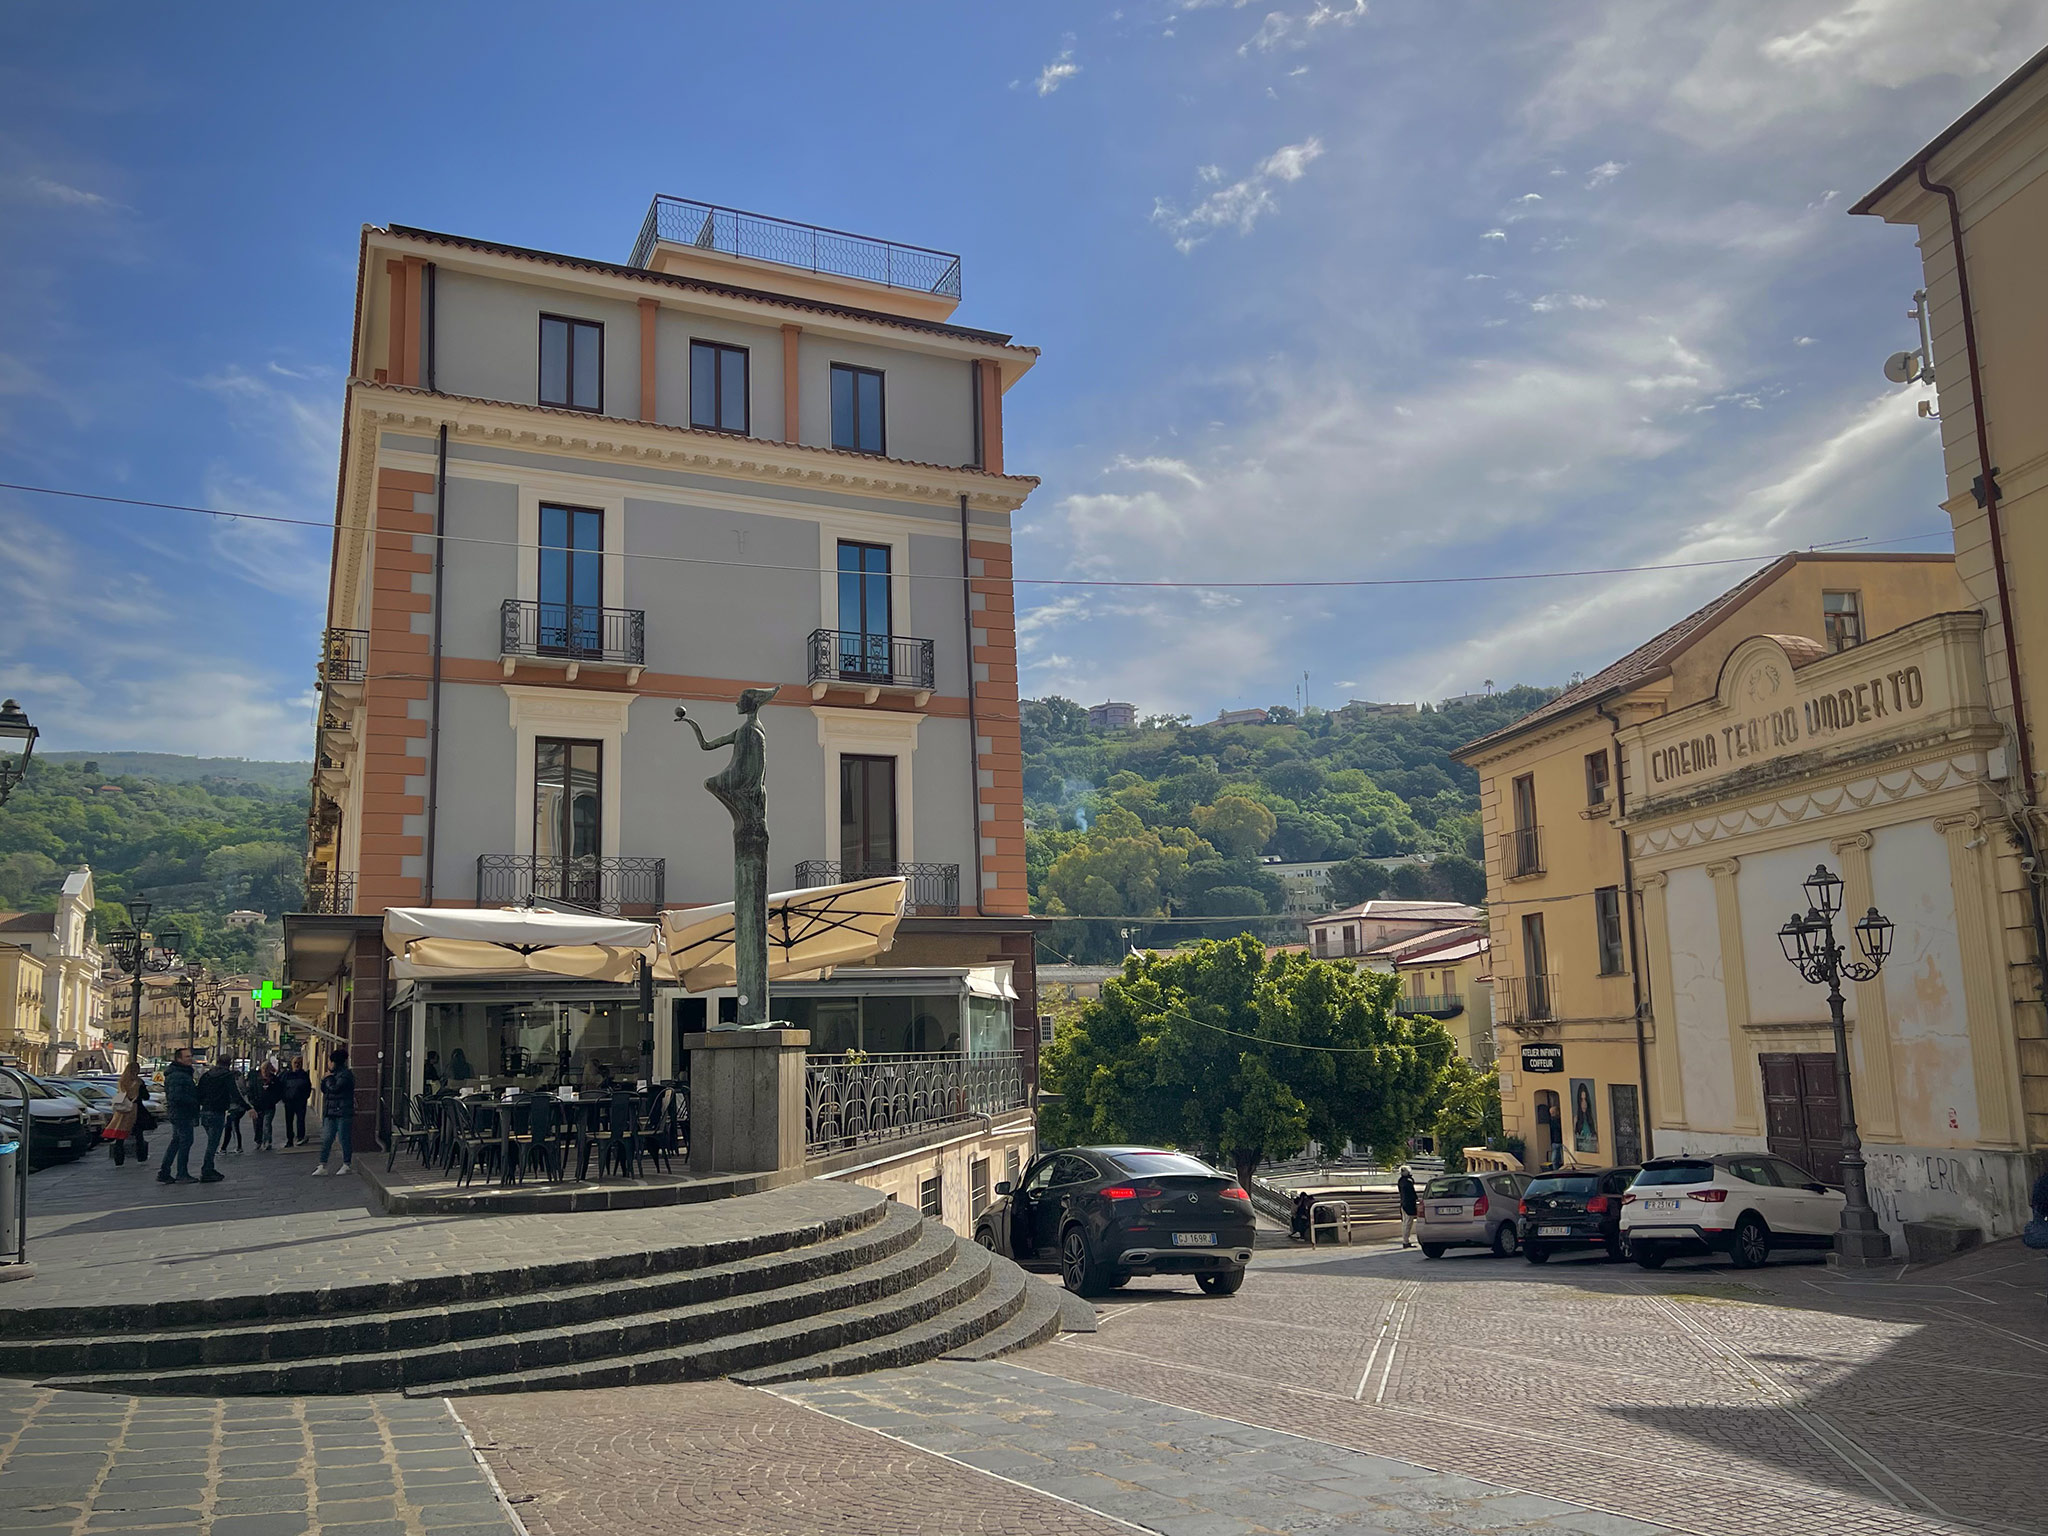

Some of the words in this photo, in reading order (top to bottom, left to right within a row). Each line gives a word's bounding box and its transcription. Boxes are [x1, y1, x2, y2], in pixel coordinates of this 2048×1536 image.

[1651, 733, 1718, 783] CINEMA
[1721, 706, 1799, 761] TEATRO
[1804, 665, 1924, 736] UMBERTO
[1522, 1048, 1539, 1056] ATELIER
[1530, 1059, 1553, 1067] COIFFEUR
